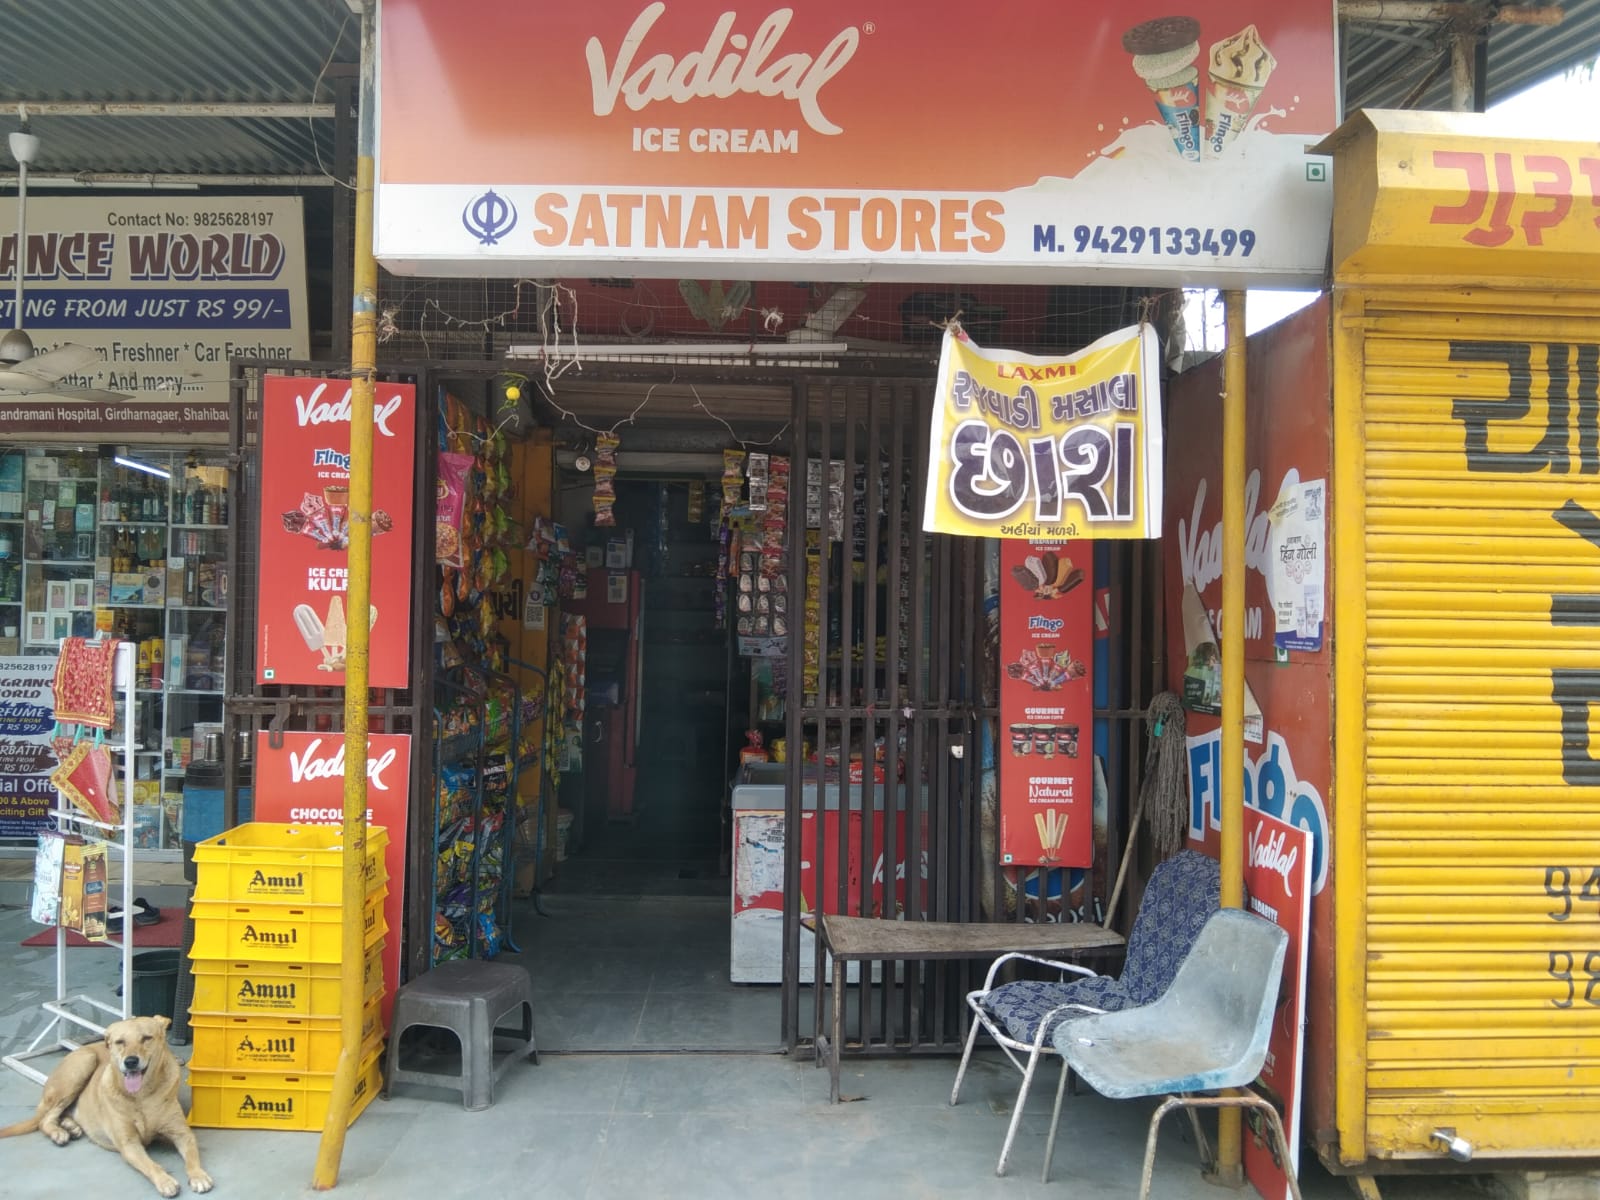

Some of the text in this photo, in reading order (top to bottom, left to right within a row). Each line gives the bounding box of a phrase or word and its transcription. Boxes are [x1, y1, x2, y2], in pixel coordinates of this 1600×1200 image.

[586, 1, 861, 136] Vadilal
[633, 127, 799, 155] ICE CREAM
[107, 212, 274, 228] Contact No: 9825628197
[533, 193, 1006, 254] SATNAM STORES
[1033, 224, 1256, 258] M. 9429133499
[128, 232, 286, 281] WORLD
[0, 298, 284, 320] TNG FROM JUST RS 99/-
[113, 342, 179, 362] Freshner
[195, 342, 221, 362] Car
[225, 342, 292, 361] Fershner
[108, 372, 138, 391] And
[997, 364, 1077, 381] LAXMI
[0, 408, 54, 421] andramani
[57, 408, 103, 423] Hospital,
[295, 383, 402, 437] Vadal
[313, 448, 350, 470] Fling
[308, 568, 349, 578] ICE CRE
[1028, 614, 1064, 632] Flingo
[290, 738, 396, 791] Vadal
[24, 778, 57, 793] Offe
[1029, 785, 1073, 799] Natural
[28, 807, 45, 816] Gift
[290, 808, 373, 820] CHOCOLE
[1248, 820, 1298, 898] Vadilal
[249, 870, 303, 888] Amul
[240, 925, 297, 944] Amul
[237, 980, 296, 999] Amul
[239, 1095, 293, 1113] Amul
